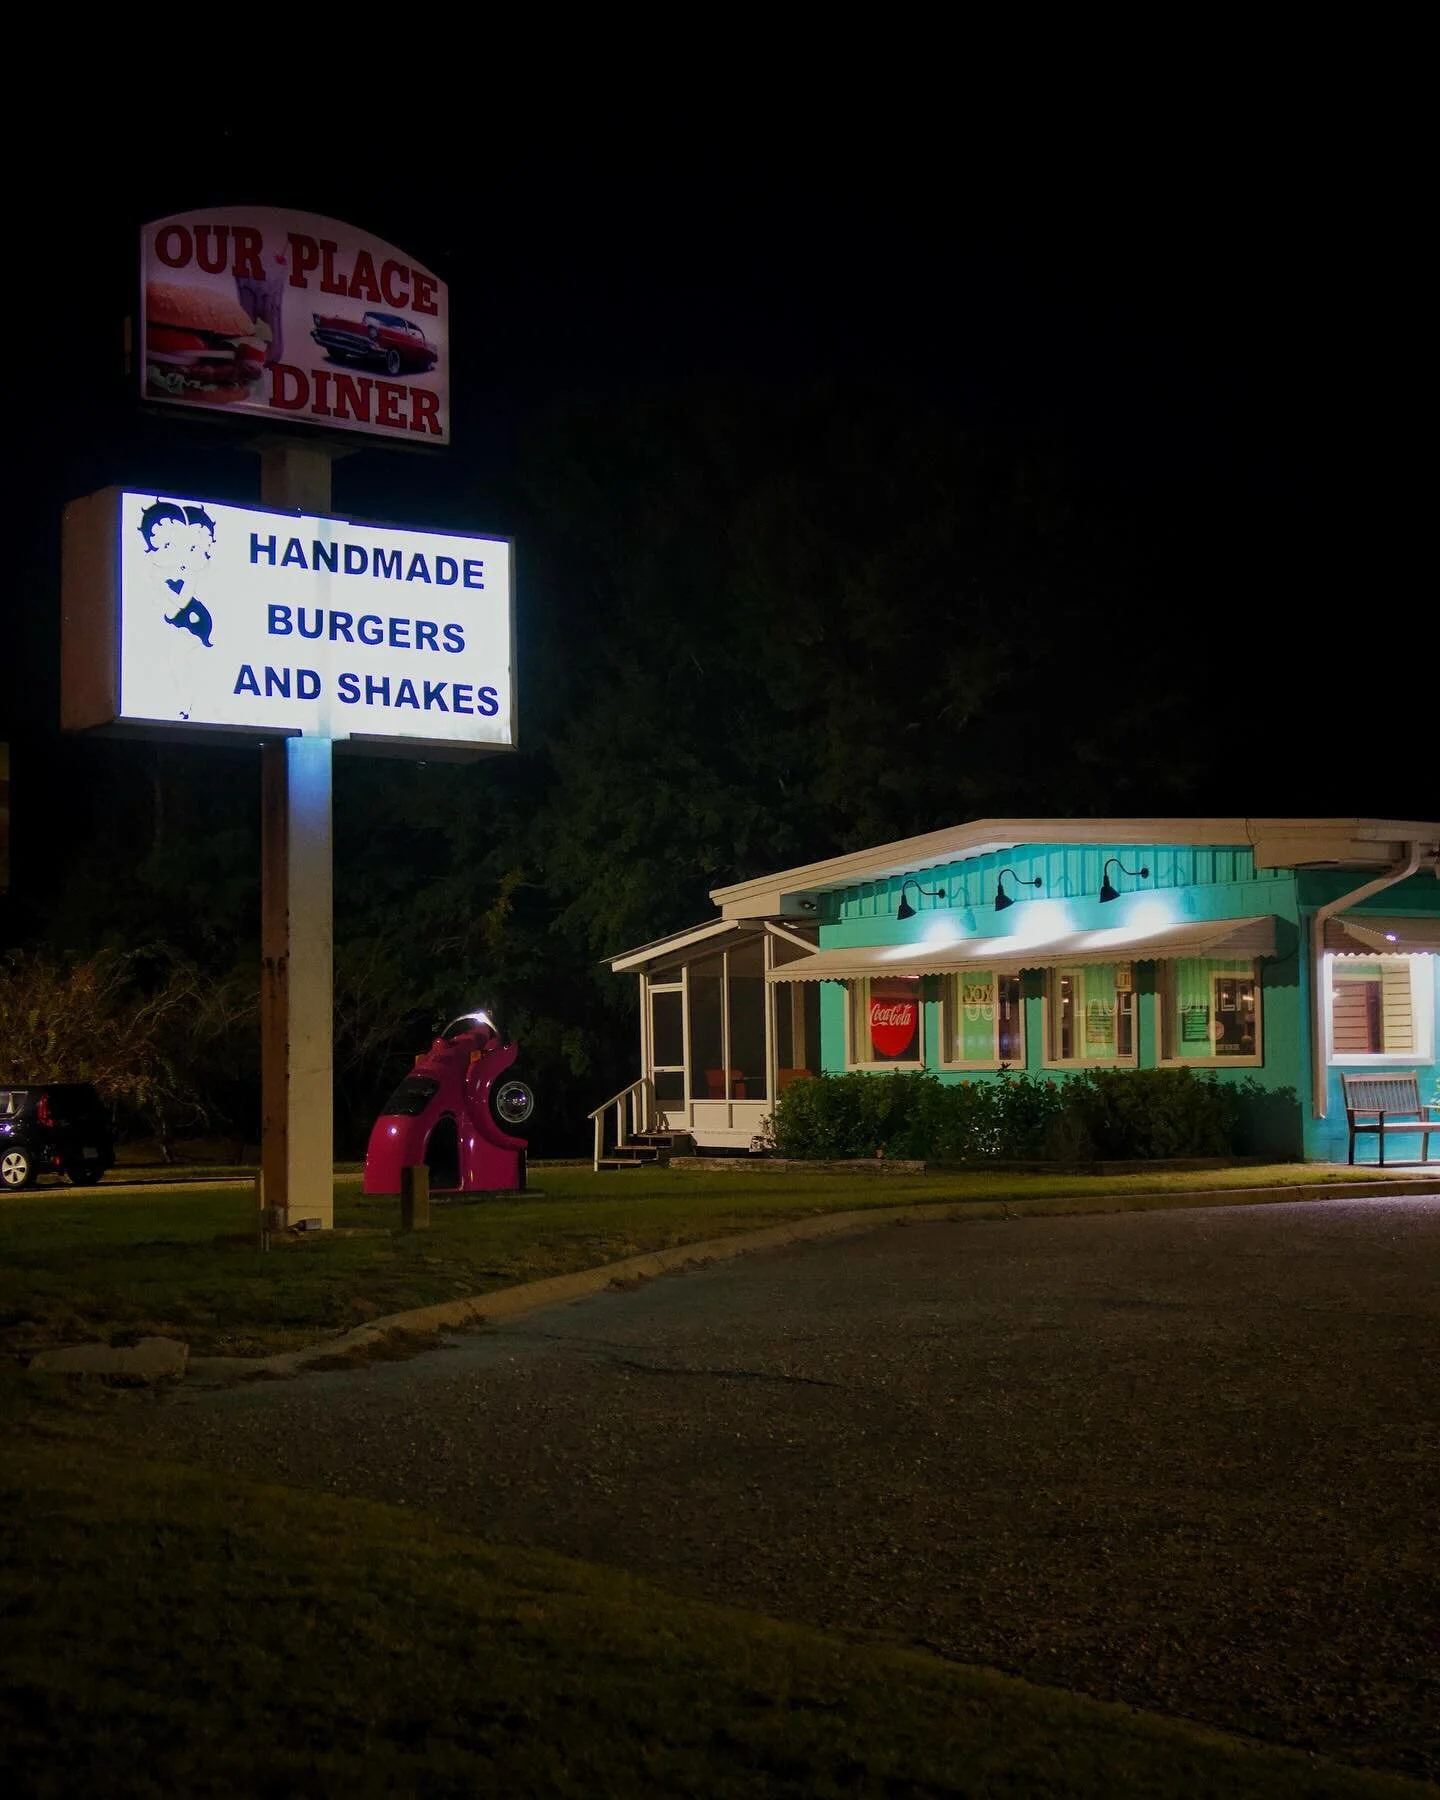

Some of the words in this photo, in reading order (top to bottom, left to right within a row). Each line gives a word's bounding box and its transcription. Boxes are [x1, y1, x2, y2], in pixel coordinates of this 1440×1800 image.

[155, 225, 265, 281] OUR
[287, 231, 439, 316] PLACE
[269, 362, 443, 436] DINER
[249, 533, 485, 590] HANDMADE
[267, 604, 466, 654] BURGERS
[232, 664, 322, 700] AND
[337, 672, 500, 717] SHAKES
